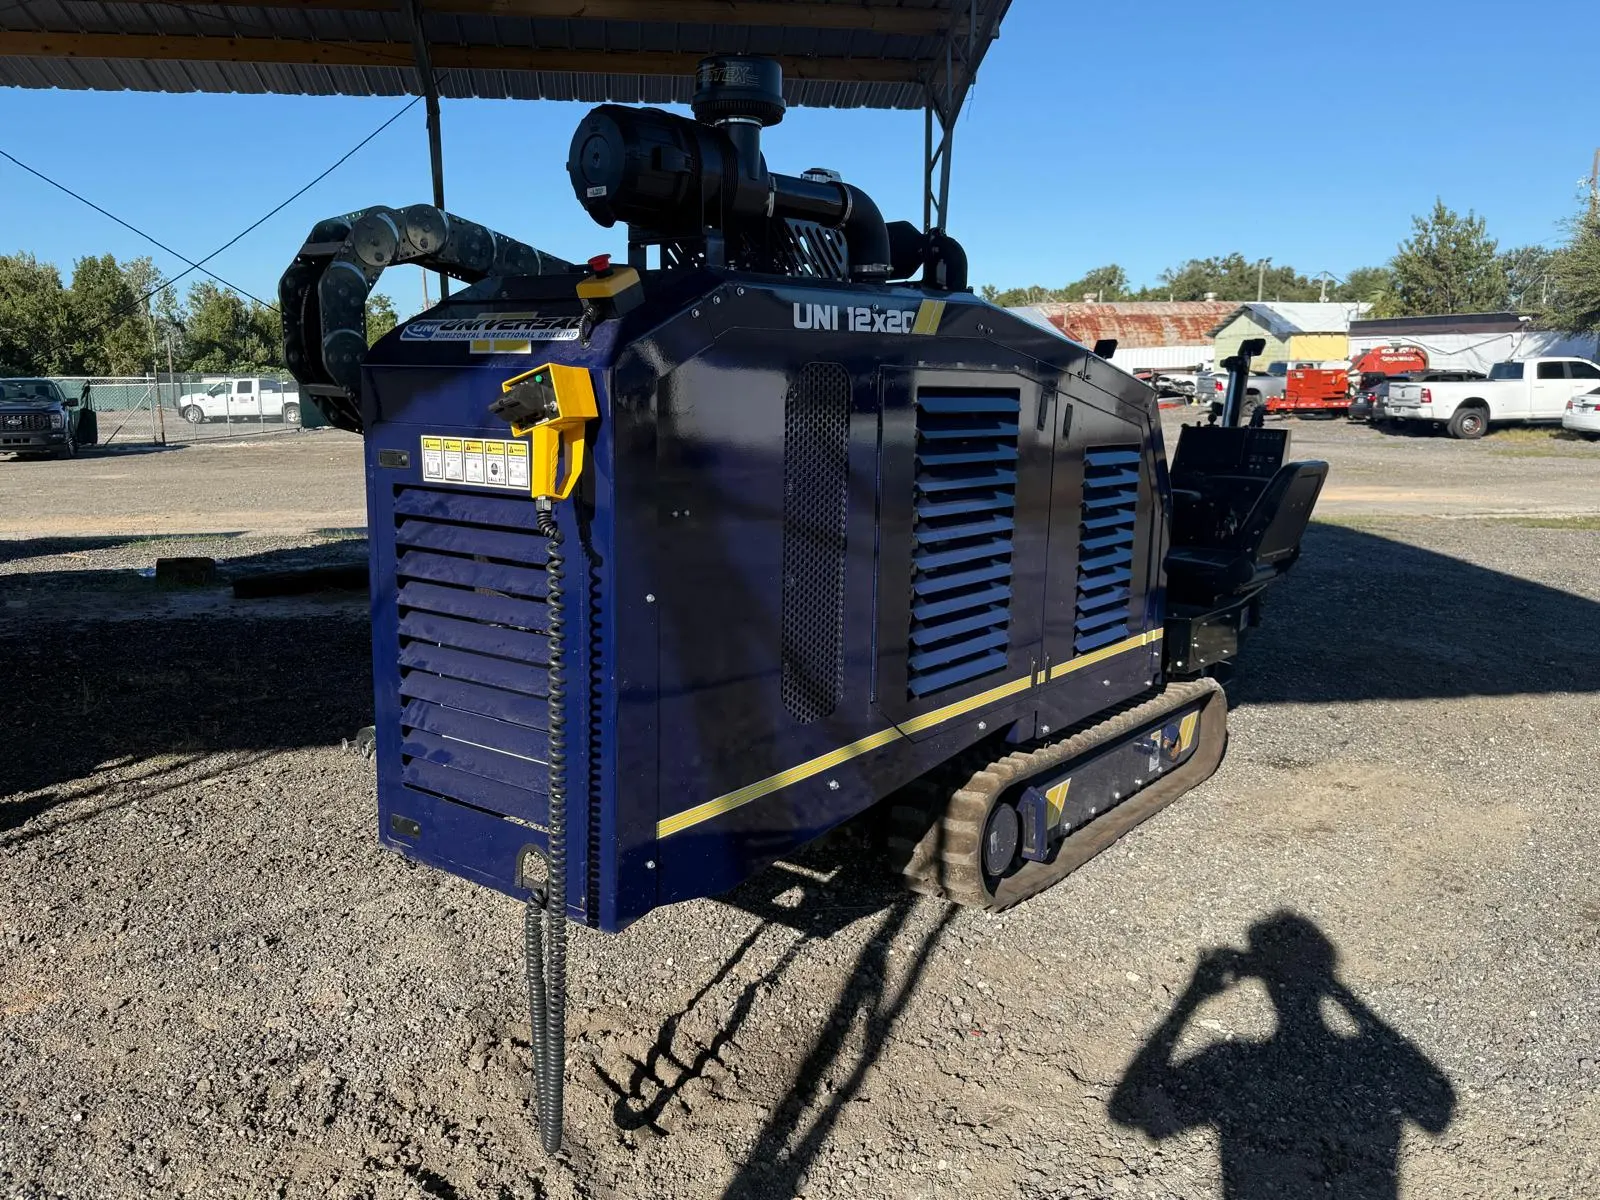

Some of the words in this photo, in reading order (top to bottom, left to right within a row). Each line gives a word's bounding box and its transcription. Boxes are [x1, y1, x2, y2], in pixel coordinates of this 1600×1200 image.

[793, 302, 838, 331] UNI
[847, 306, 915, 334] 12x20
[412, 324, 437, 332] UNI
[439, 318, 580, 331] UNIVERSAL
[538, 331, 578, 339] DRILLING
